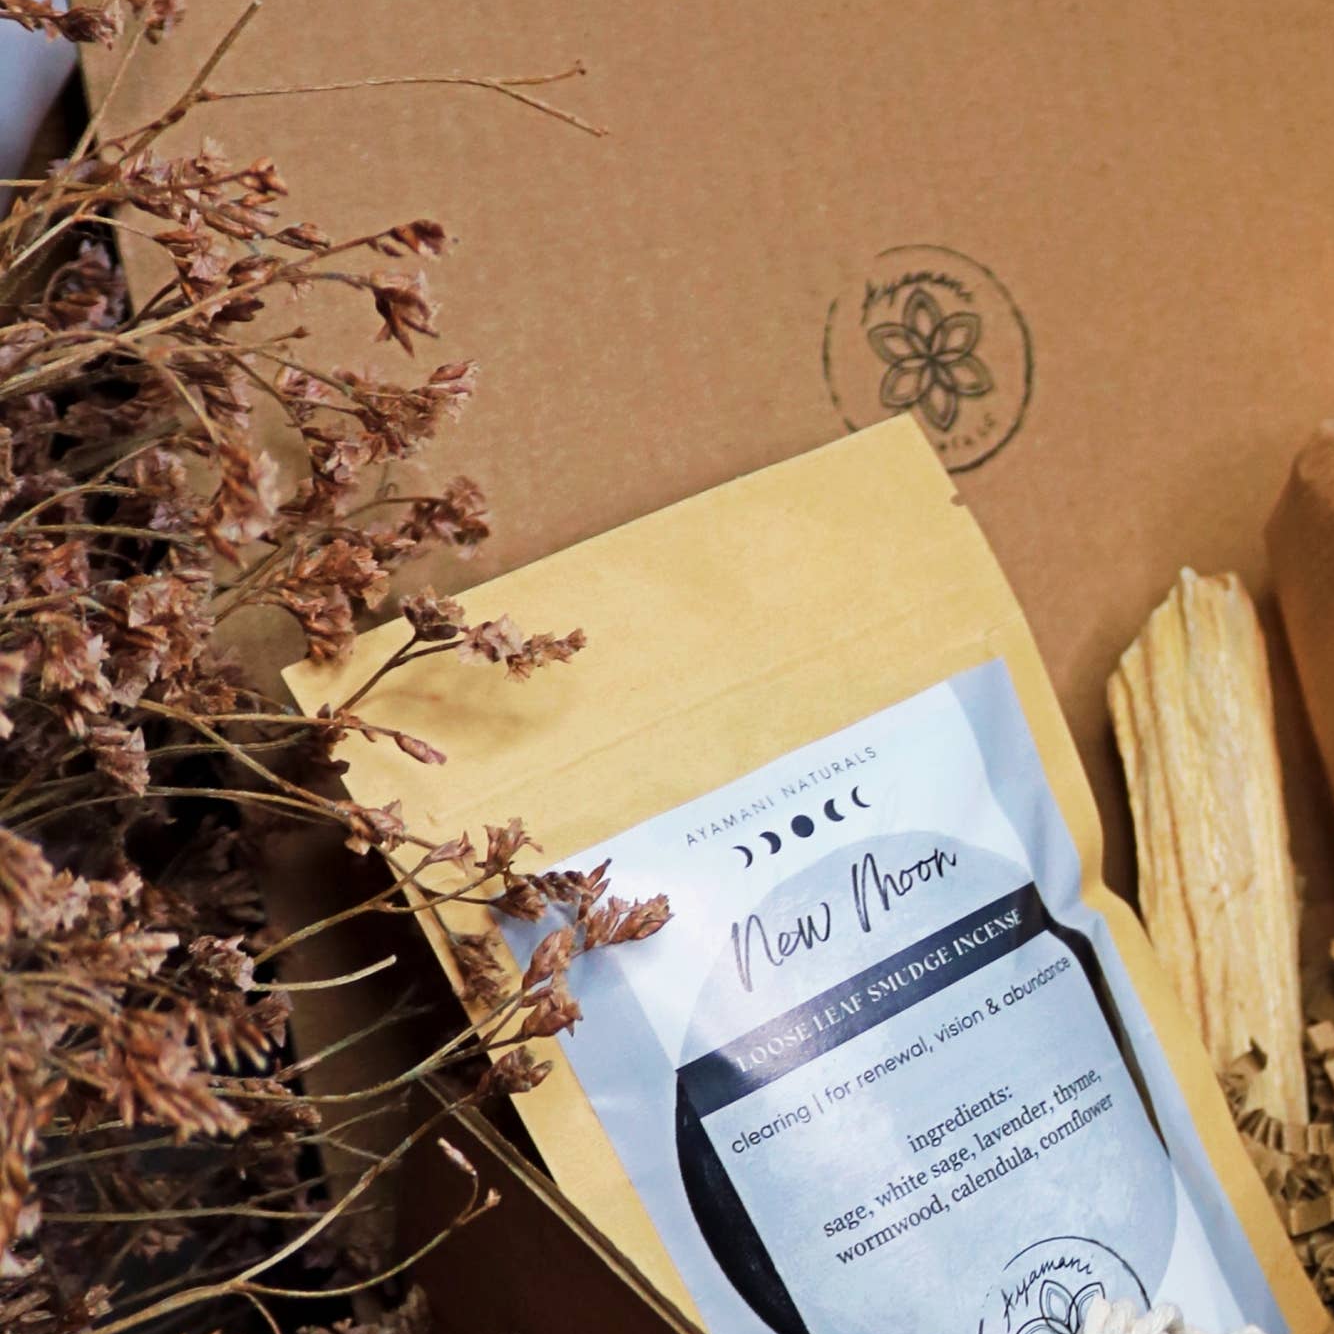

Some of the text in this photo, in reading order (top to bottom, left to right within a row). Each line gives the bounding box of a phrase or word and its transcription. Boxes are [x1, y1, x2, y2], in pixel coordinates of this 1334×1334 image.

[686, 747, 876, 846] AYAMANI NATURALS
[731, 848, 956, 992] New Moon
[736, 909, 1021, 1073] LOOSE LEAF SMUDGE INCENSE
[732, 1106, 811, 1153] clearing
[825, 1081, 851, 1103] for
[857, 1036, 933, 1087] renewal,
[934, 1010, 984, 1042] vision
[985, 997, 1002, 1016] &
[1003, 957, 1070, 1006] abundance
[907, 1086, 1012, 1153] ingredients:
[824, 1070, 1101, 1237] sage, white sage, lavender, thyme,
[836, 1094, 1112, 1264] wormwood, calendula, cornflower
